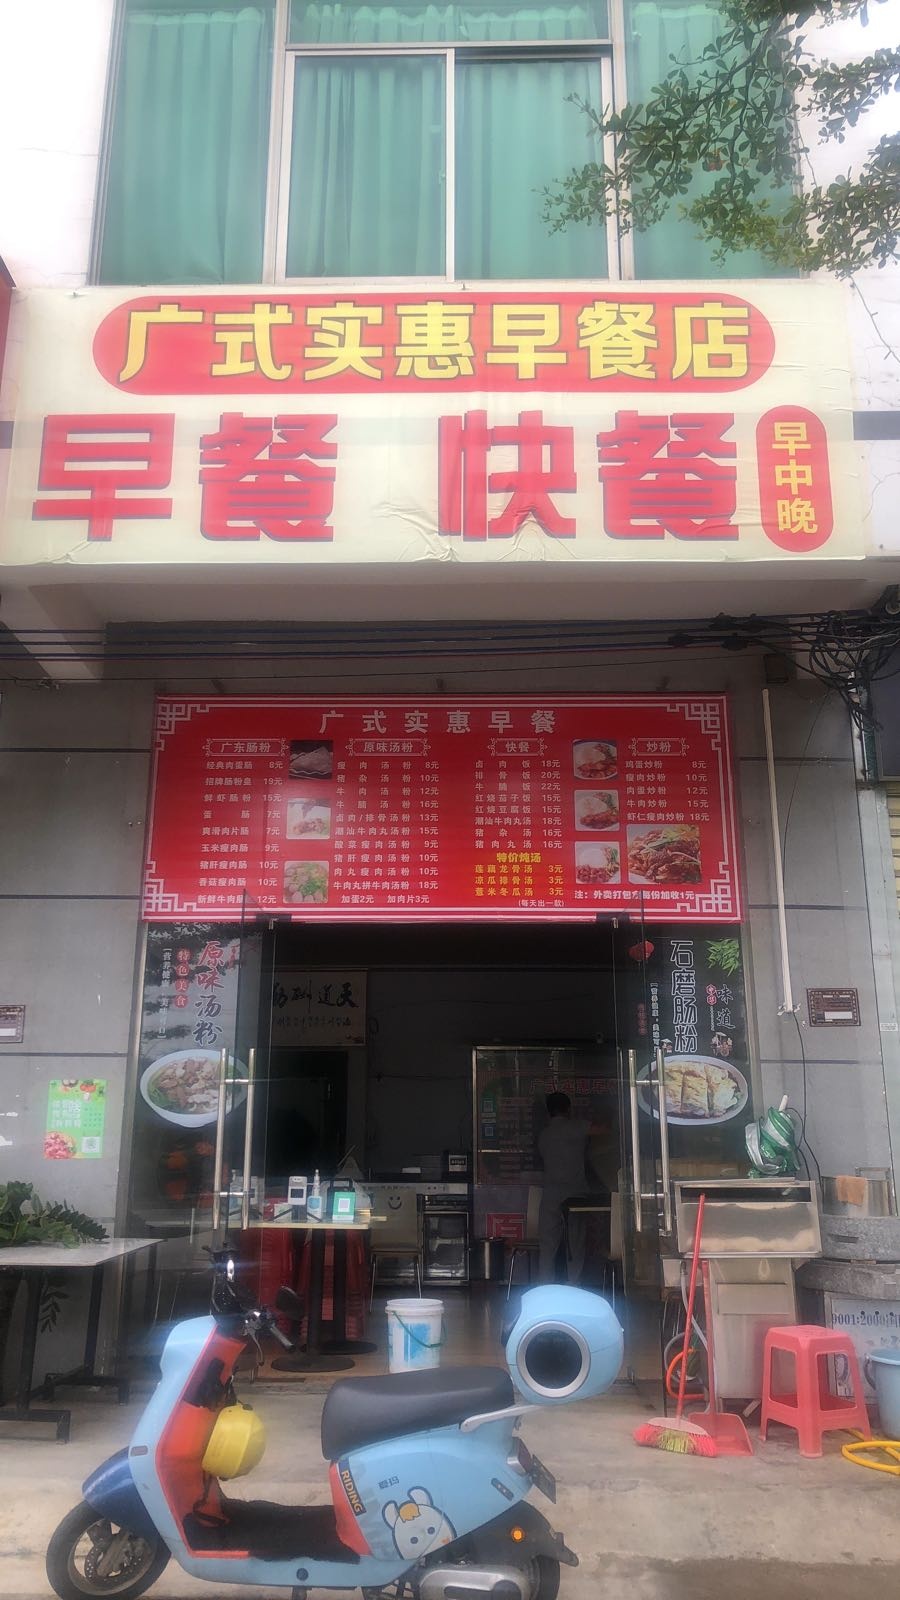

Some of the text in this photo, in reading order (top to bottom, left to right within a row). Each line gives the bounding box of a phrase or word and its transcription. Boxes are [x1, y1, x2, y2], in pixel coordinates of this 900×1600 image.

[118, 301, 750, 383] 广式实惠早餐店
[32, 409, 738, 543] 早餐 快餐
[771, 421, 818, 534] 早中晚
[319, 709, 556, 734] 广式实惠早餐
[220, 742, 271, 753] 广东肠粉
[363, 741, 413, 753] 原味汤粉
[505, 741, 530, 753] 快餐
[646, 741, 672, 753] 炒粉
[206, 761, 284, 770] 经典肉蛋肠 8元
[337, 761, 440, 770] 瘦肉汤粉 8元
[475, 760, 561, 768] 卤肉饭 18元
[625, 760, 707, 769] 鸡蛋炒粉 8元
[336, 774, 440, 783] 猪杂汤粉 10元
[475, 771, 561, 780] 排骨饭 20元
[625, 773, 708, 782] 瘦肉炒粉 10元
[263, 777, 283, 785] 19元
[335, 787, 439, 796] 牛肉汤粉 12元
[475, 783, 561, 791] 牛腩饭 22元
[626, 786, 709, 795] 肉蛋炒粉 12元
[203, 794, 282, 803] 鲜虾肠粉 15元
[475, 794, 561, 803] 红烧茄子饭 15元
[335, 800, 439, 809] 牛腩汤粉 16元
[626, 799, 709, 809] 牛肉炒粉 15元
[267, 810, 281, 818] 7元
[475, 806, 562, 814] 红烧豆腐饭 15元
[335, 813, 439, 823] 卤肉/排骨汤粉 13元
[475, 817, 562, 825] 潮汕牛肉丸汤 18元
[627, 813, 710, 822] 虾仁瘦肉炒粉 18元
[201, 826, 280, 836] 爽滑肉片肠 7元
[335, 827, 439, 836] 潮汕牛肉丸汤粉 15元
[475, 828, 562, 837] 猪杂汤 16元
[201, 843, 280, 853] 玉米瘦肉肠 9元
[334, 840, 439, 849] 酸菜瘦肉汤粉 9元
[475, 840, 562, 849] 猪肉丸汤 16元
[334, 854, 439, 863] 猪肝瘦肉汤粉 10元
[496, 852, 541, 863] 特价炖汤
[199, 860, 279, 869] 猪肝瘦肉肠 10元
[548, 865, 563, 873] 3元
[334, 868, 439, 877] 肉丸瘦肉汤粉 10元
[198, 878, 278, 887] 香菇瘦肉肠 10元
[475, 876, 564, 885] 凉瓜排骨汤 3元
[333, 881, 439, 890] 牛肉丸拼牛肉汤粉 18元
[475, 888, 564, 897] 薏米冬瓜汤 3元
[256, 895, 277, 904] 12元
[341, 895, 430, 904] 加蛋2元 加肉片3元
[176, 947, 191, 1007] 特色美食
[192, 940, 225, 1046] 原味汤粉
[670, 940, 698, 1053] 石磨肠粉
[716, 983, 736, 1030] 味道
[340, 1470, 365, 1514] RIDING
